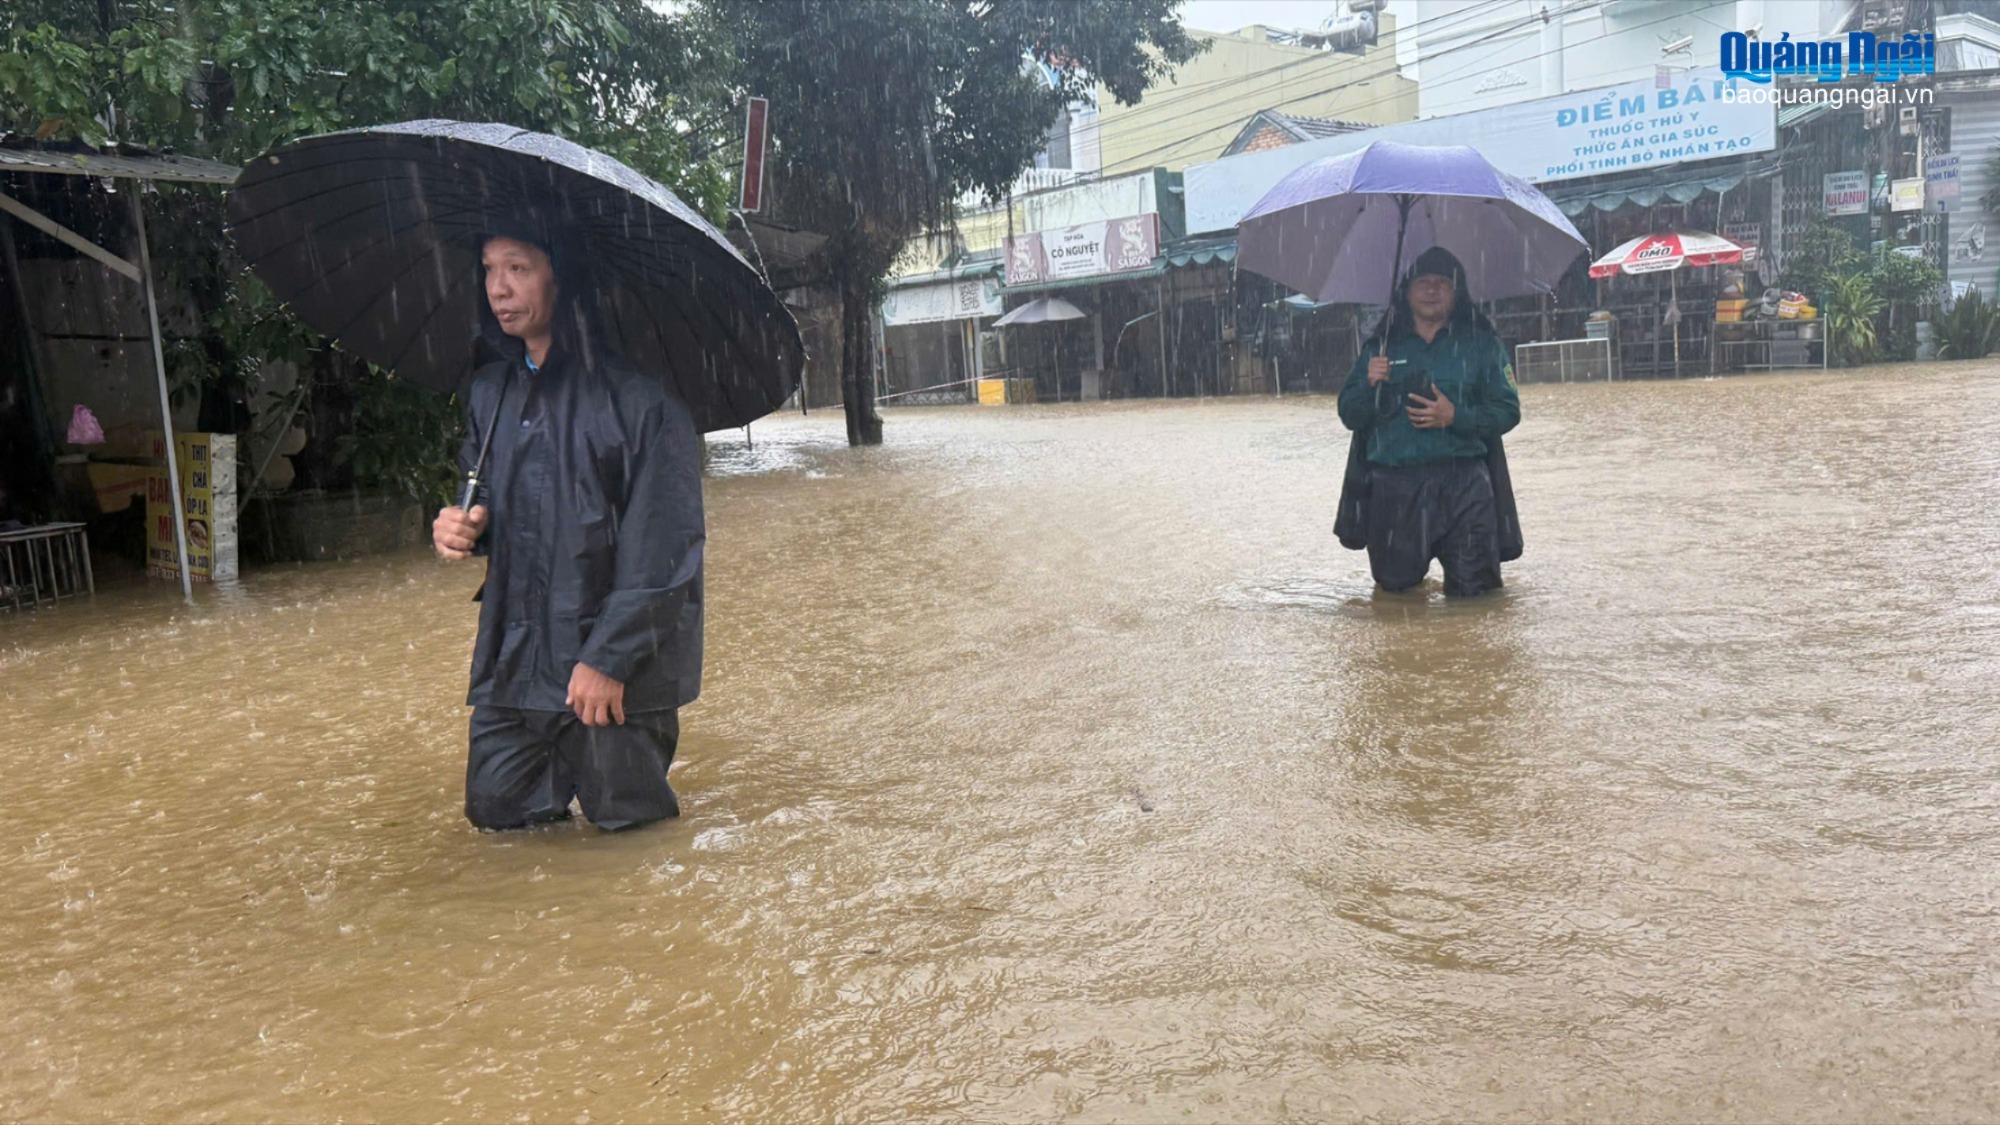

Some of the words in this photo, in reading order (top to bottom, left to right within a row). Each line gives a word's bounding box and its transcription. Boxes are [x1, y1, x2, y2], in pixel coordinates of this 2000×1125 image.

[1556, 92, 1645, 128] ĐIỂM
[1589, 119, 1644, 139] THUỐC
[1649, 111, 1683, 131] THÚ
[1689, 111, 1699, 121] Y
[1573, 141, 1617, 157] THỨC
[1649, 132, 1678, 144] GIA
[1683, 124, 1719, 139] SÚC
[1546, 159, 1584, 176] PHỐI
[1588, 156, 1627, 169] TINH
[1714, 136, 1752, 152] TẠO
[1065, 241, 1100, 256] NGUYỆT
[1639, 247, 1671, 258] OMO
